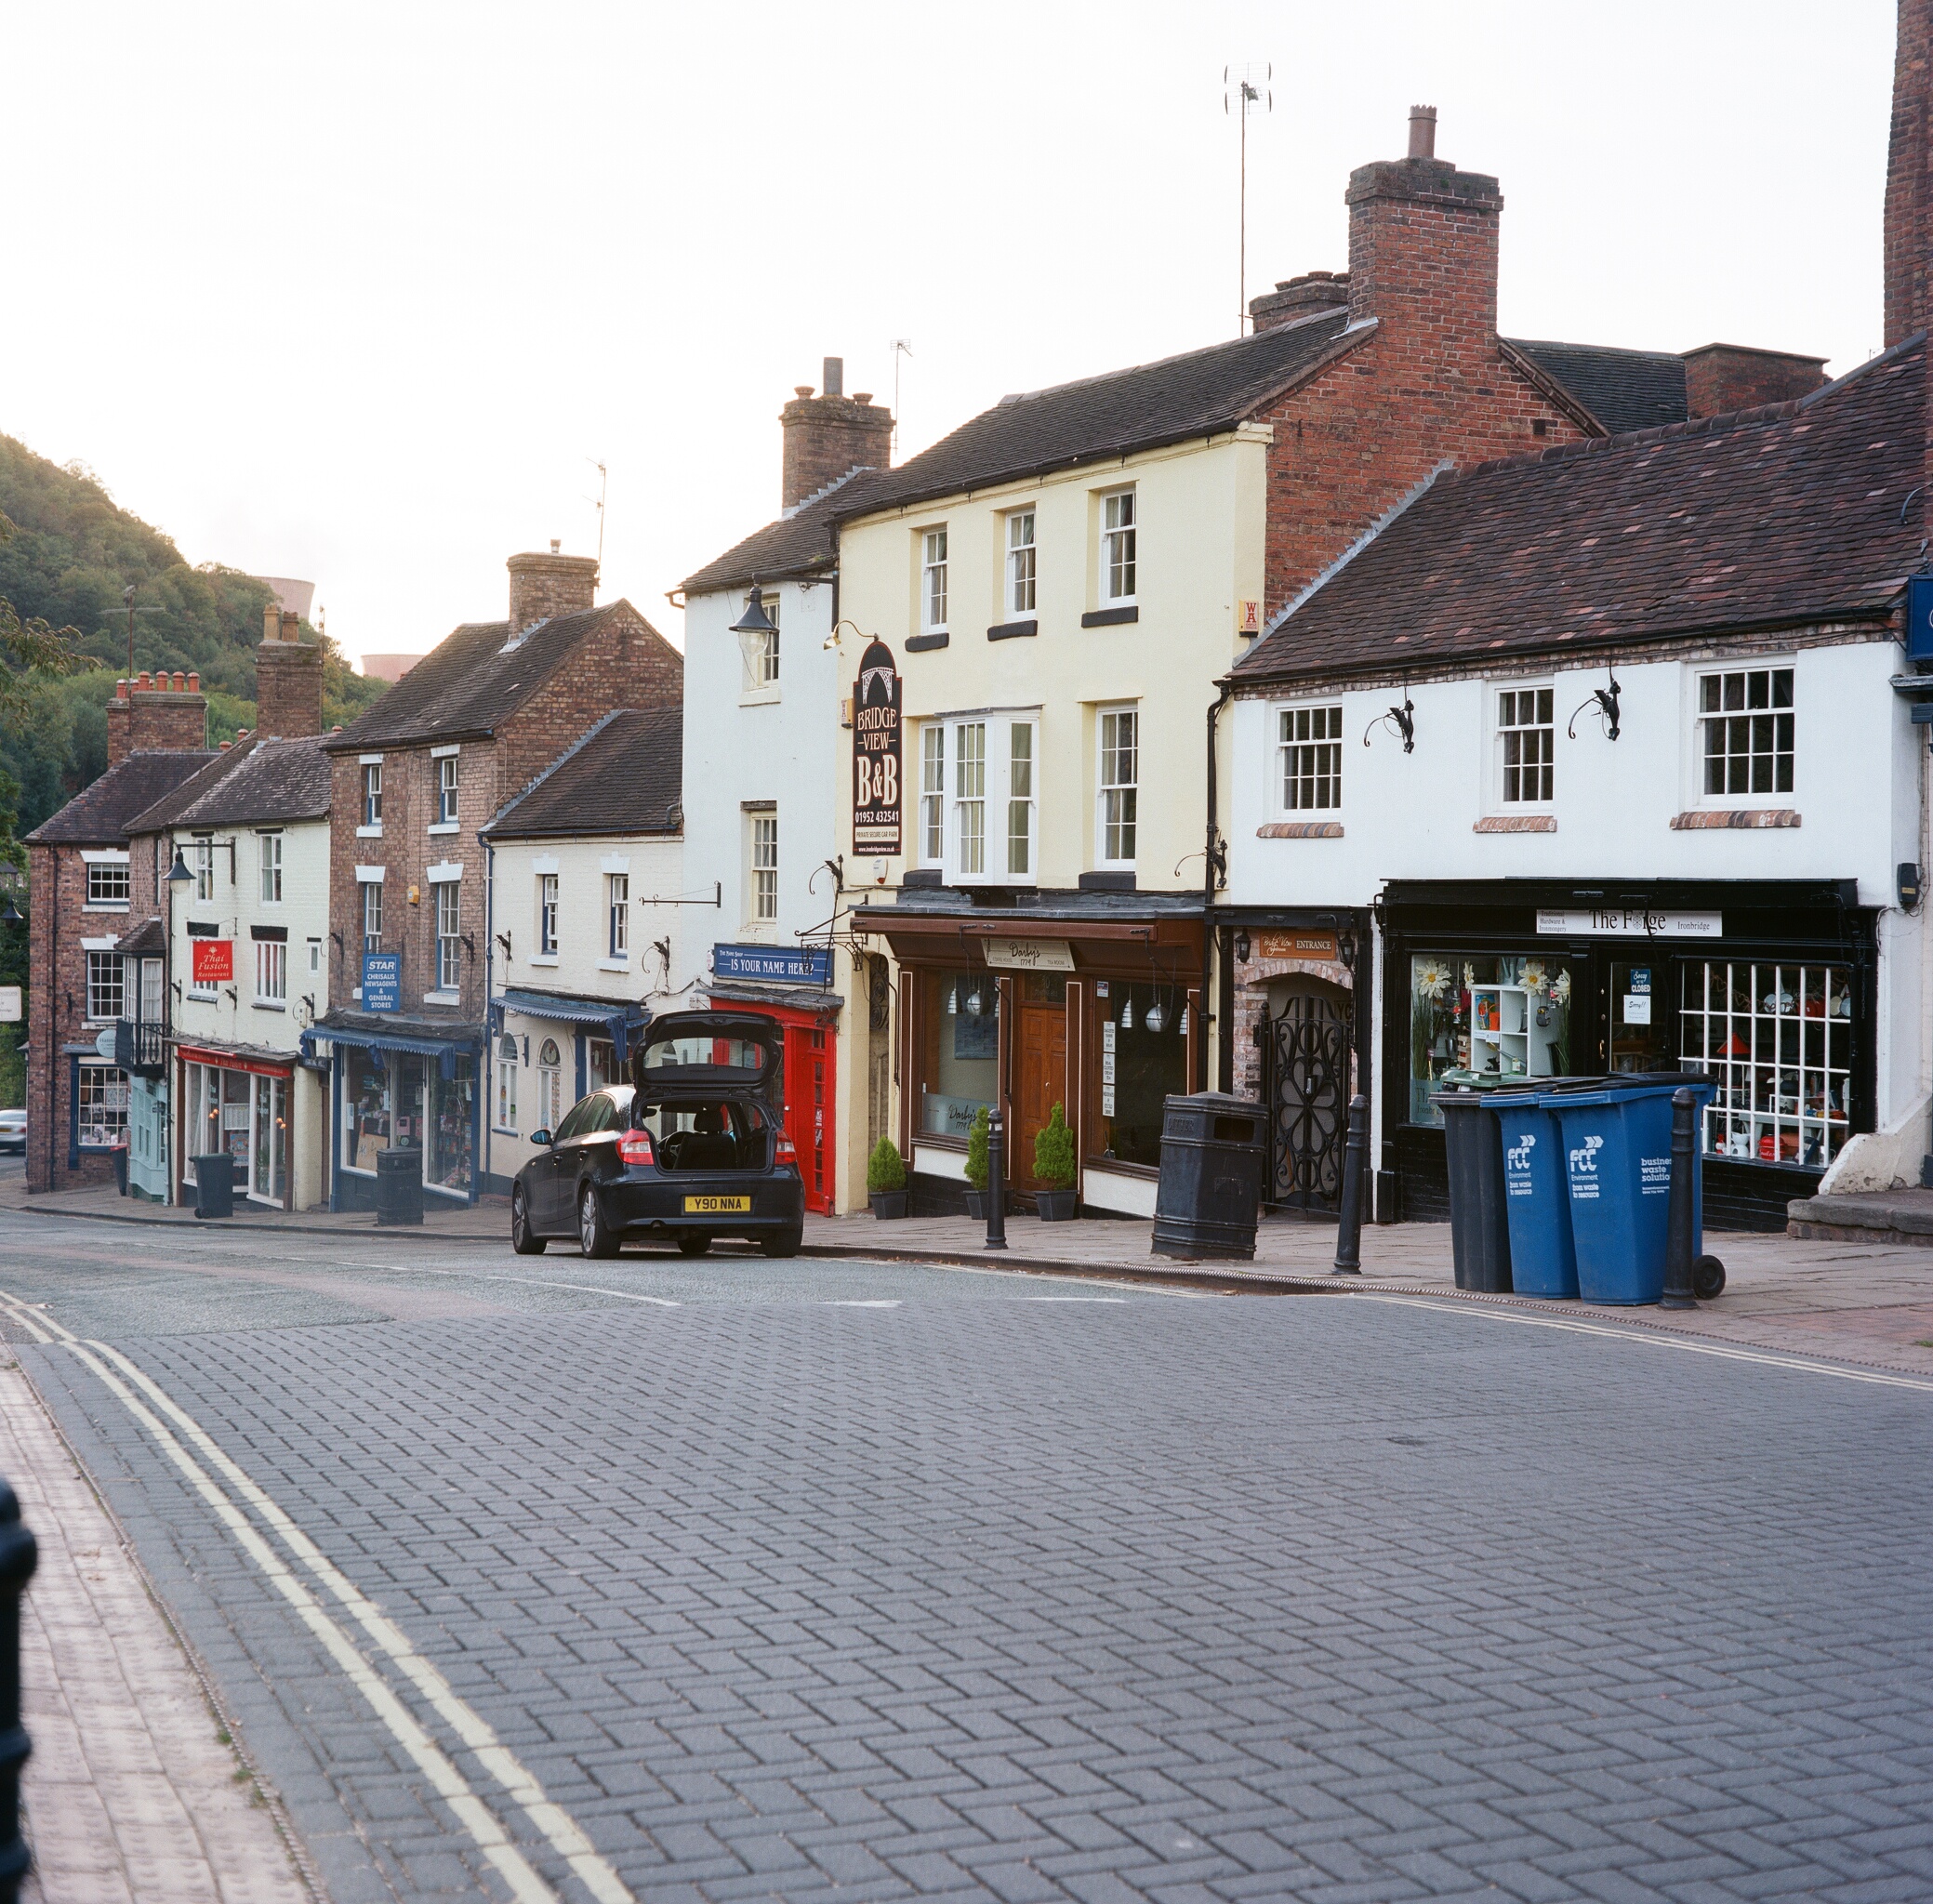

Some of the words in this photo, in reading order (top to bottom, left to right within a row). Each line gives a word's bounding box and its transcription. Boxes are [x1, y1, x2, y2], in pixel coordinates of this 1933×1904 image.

[857, 707, 897, 730] BRIDGE
[863, 732, 890, 750] VIEW
[857, 754, 897, 806] B&B
[855, 811, 874, 823] 01952
[875, 810, 899, 823] 432541
[1589, 910, 1618, 929] The
[1677, 921, 1710, 931] Ironbridge
[1296, 940, 1331, 950] ENTRANCE
[204, 954, 225, 963] Thai
[1010, 942, 1040, 966] Darby's
[198, 961, 229, 971] Fusion
[368, 961, 395, 970] STAR
[731, 959, 738, 971] IS
[740, 959, 761, 972] YOUR
[762, 960, 785, 974] NAME
[1634, 971, 1648, 982] Sorry
[1631, 984, 1651, 993] CLOSED
[948, 1104, 977, 1130] Darby's
[1508, 1147, 1530, 1170] FCC
[1569, 1148, 1597, 1172] FCC
[1641, 1157, 1672, 1166] busine
[1641, 1173, 1670, 1182] solutio
[695, 1198, 717, 1210] Y90
[720, 1198, 742, 1210] NNA
